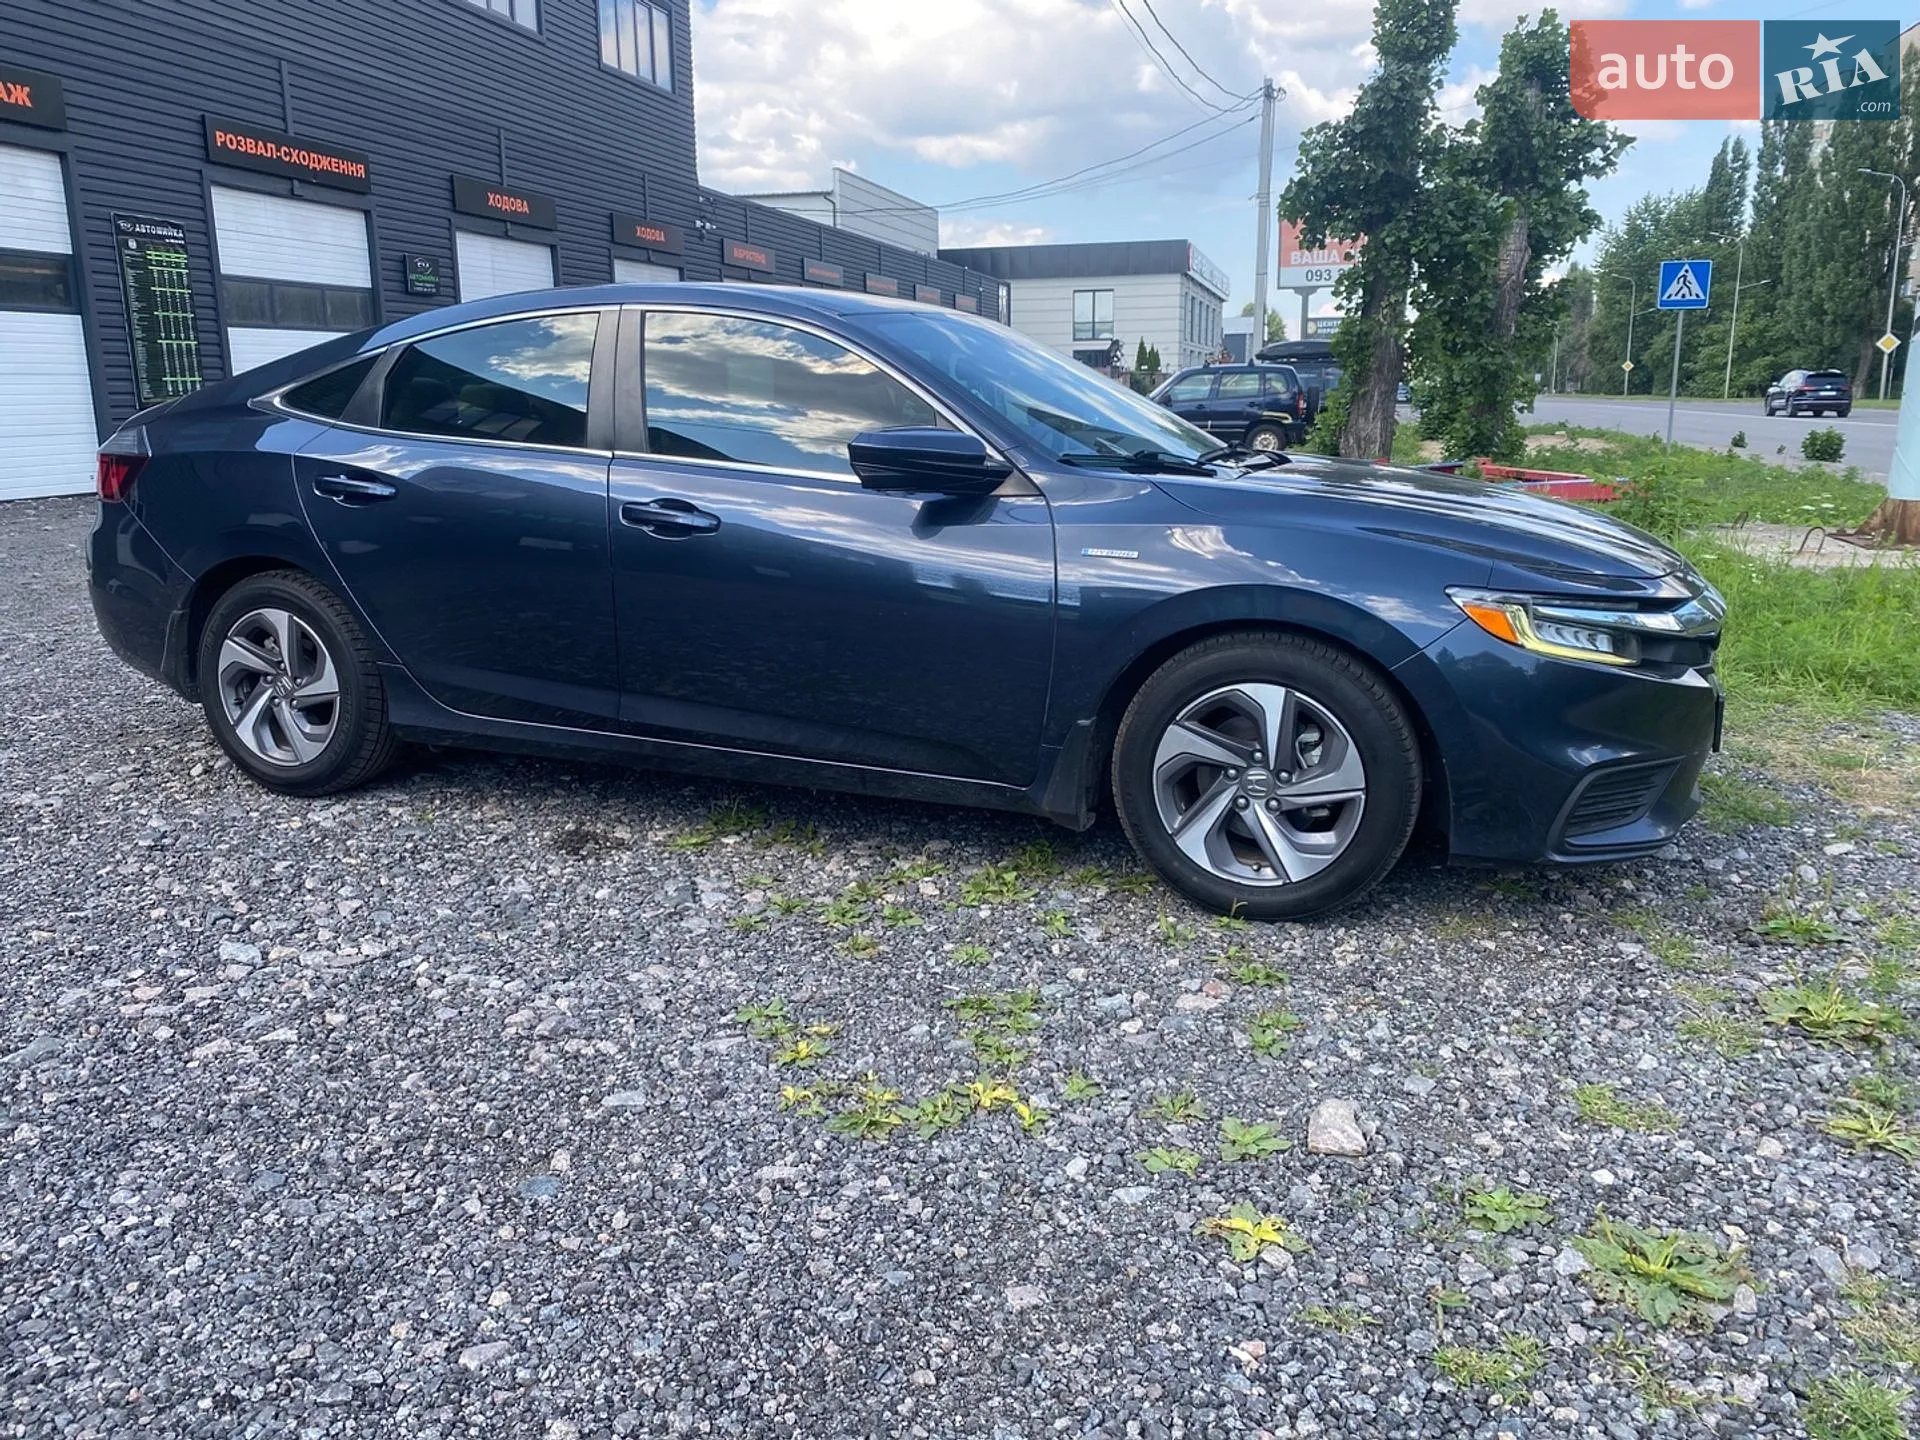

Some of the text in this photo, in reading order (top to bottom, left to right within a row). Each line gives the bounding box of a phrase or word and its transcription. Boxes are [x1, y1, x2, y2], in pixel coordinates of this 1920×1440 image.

[215, 130, 366, 179] РОЗВАЛ-СХОДЖЕННЯ
[487, 191, 530, 215] ХОДОВА
[635, 224, 666, 242] ХОДОВА
[1290, 249, 1341, 265] ВАША
[1305, 268, 1333, 282] 093
